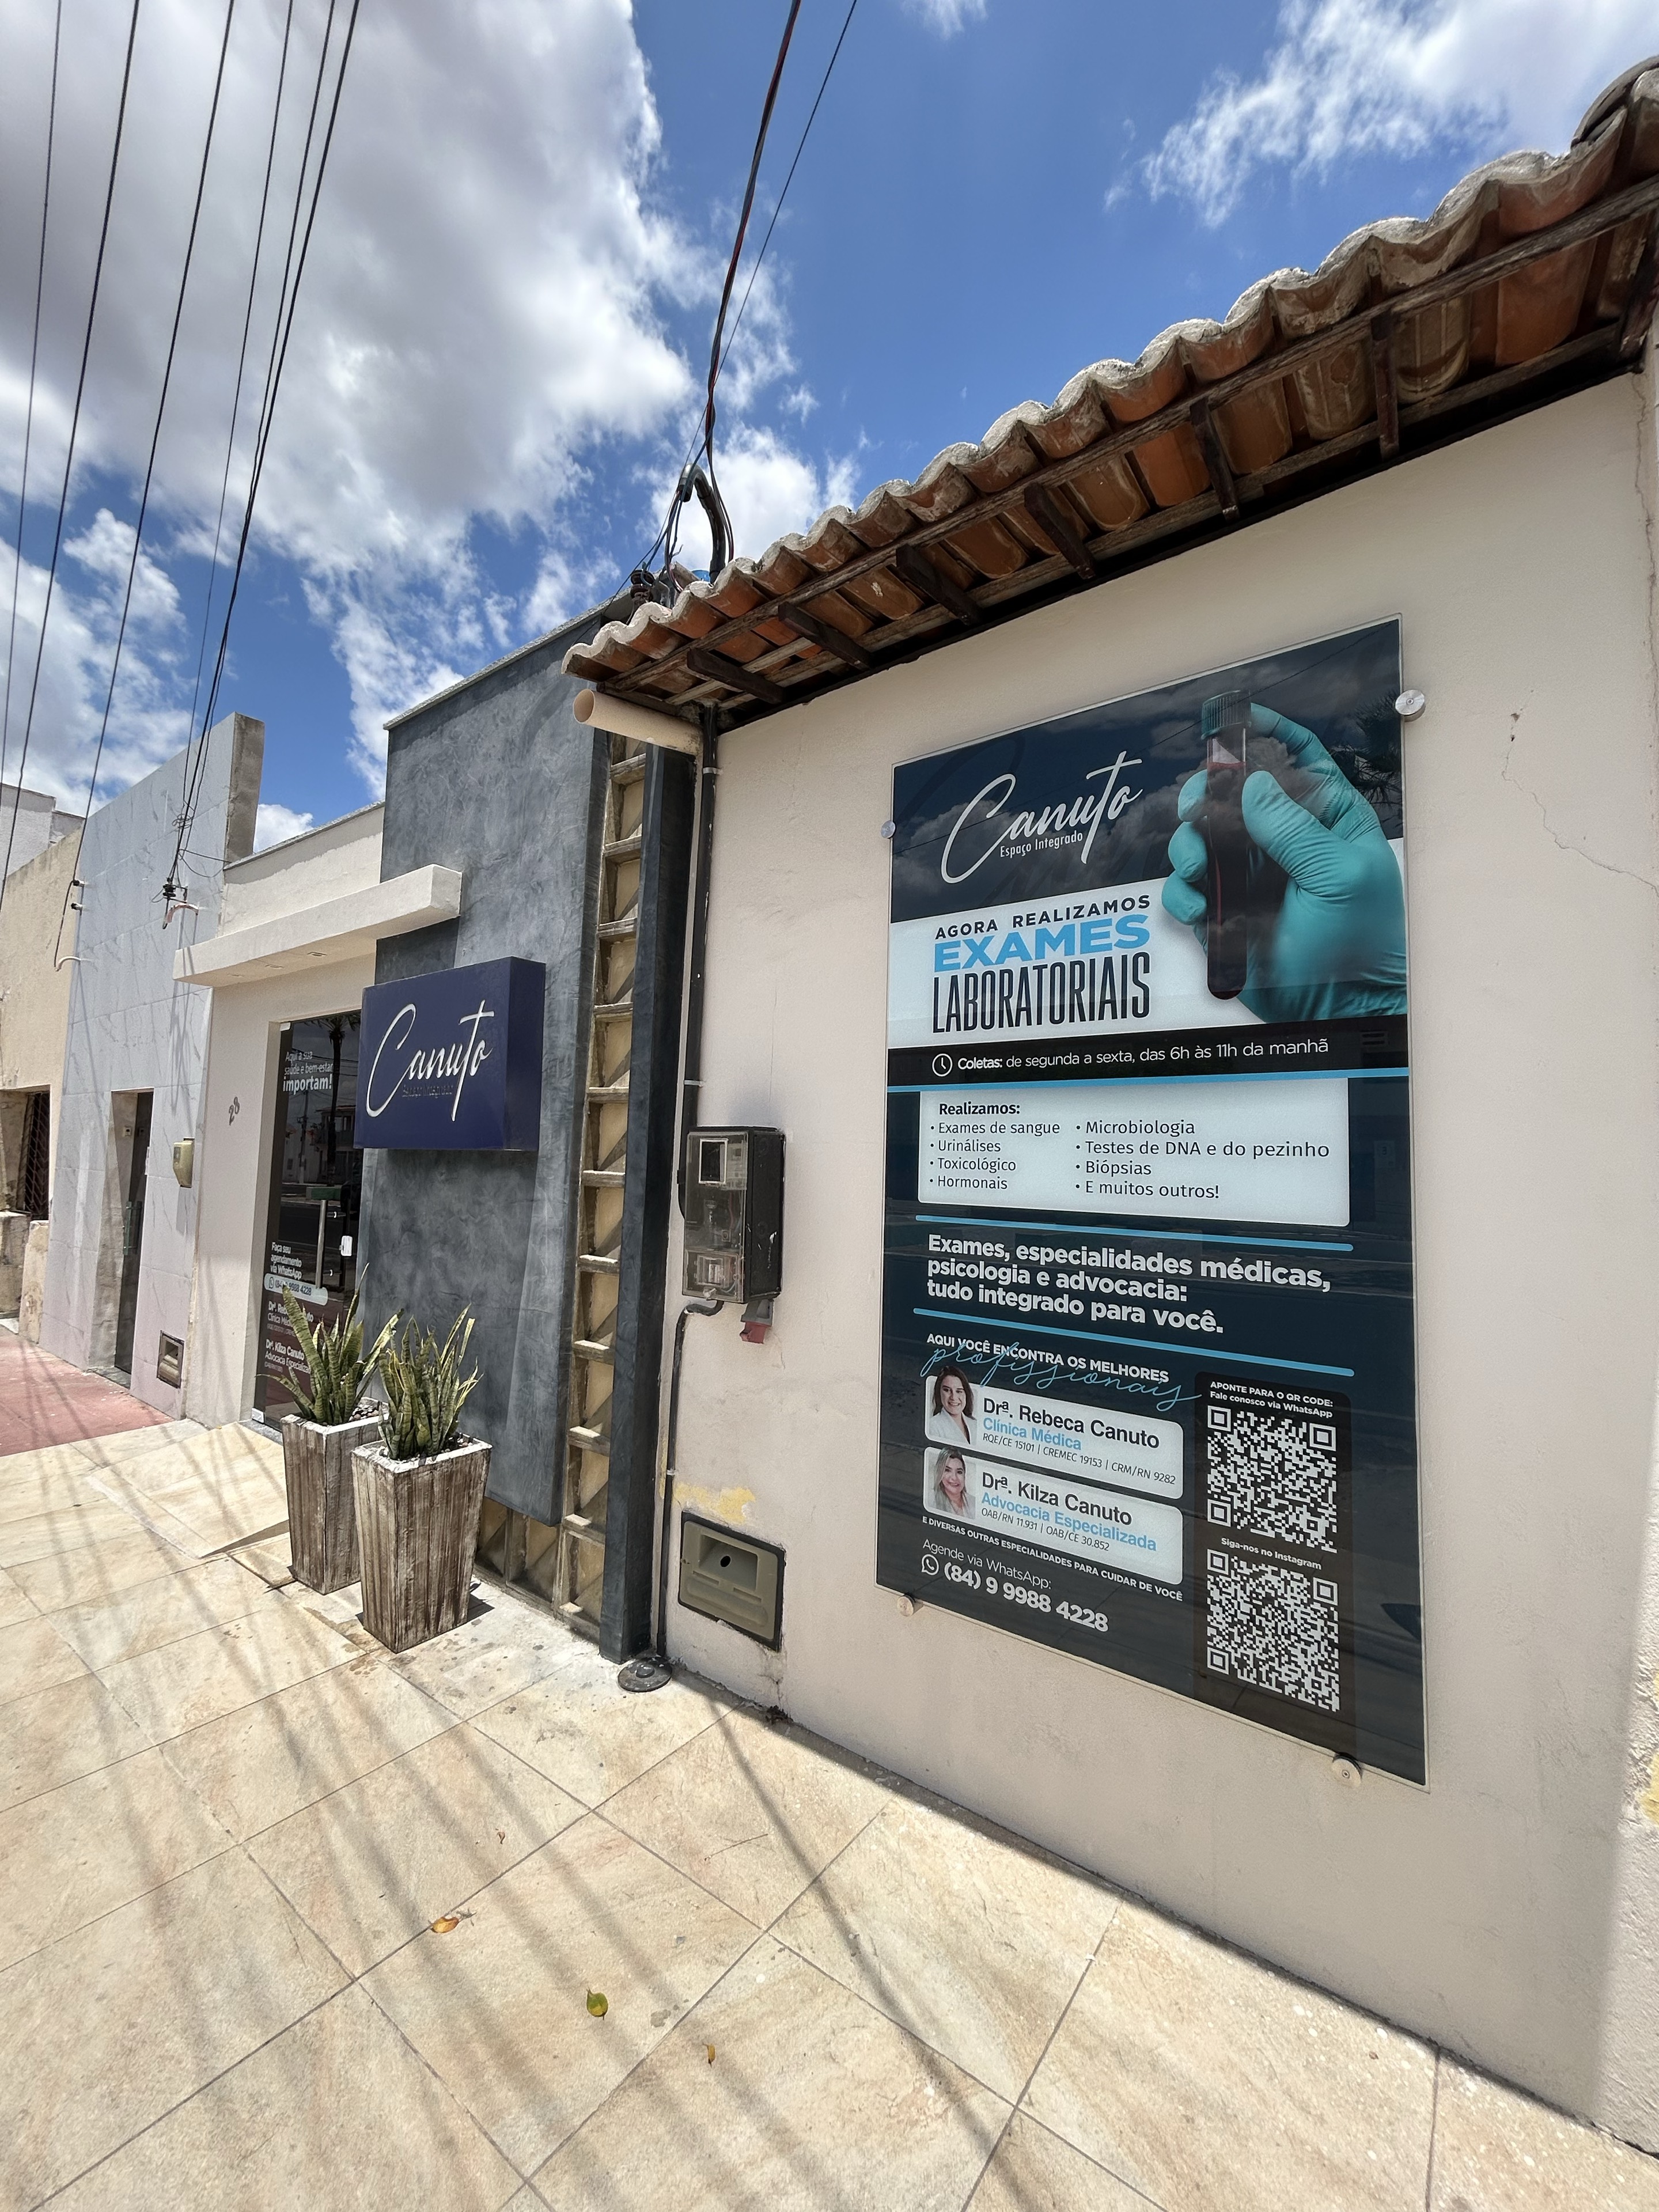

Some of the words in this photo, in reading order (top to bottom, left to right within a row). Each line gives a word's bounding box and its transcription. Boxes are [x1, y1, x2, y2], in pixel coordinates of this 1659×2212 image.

[941, 751, 1143, 884] Canuto
[1000, 842, 1031, 858] Espaço
[1035, 830, 1083, 850] Integrado
[935, 919, 998, 940] AGORA
[1013, 895, 1150, 928] REALIZAMOS
[934, 914, 1150, 972] EXAMES
[933, 952, 1150, 1033] LABORATORIAIS
[305, 1060, 333, 1074] bem-estar
[366, 999, 494, 1122] Canuto
[957, 1056, 1002, 1070] Coletas:
[1006, 1055, 1021, 1067] de
[1025, 1052, 1080, 1068] segunda
[1084, 1054, 1092, 1063] a
[1096, 1050, 1135, 1063] sexta,
[1139, 1048, 1165, 1062] das
[1170, 1046, 1190, 1060] 6h
[1195, 1045, 1211, 1059] às
[1216, 1043, 1237, 1058] 11h
[1243, 1042, 1263, 1056] da
[1269, 1038, 1328, 1055] manhã
[283, 1074, 332, 1095] importam!
[229, 1096, 240, 1126] 28
[939, 1101, 1020, 1115] Realizamos:
[938, 1122, 986, 1134] Exames
[990, 1121, 1006, 1134] de
[1010, 1122, 1060, 1137] sangue
[938, 1139, 1001, 1152] Urinálises
[1085, 1119, 1195, 1137] Microbiologia
[938, 1157, 1016, 1173] Toxicológico
[1085, 1141, 1134, 1154] Testes
[1139, 1140, 1160, 1154] de
[1165, 1142, 1201, 1156] DNA
[1207, 1144, 1217, 1156] e
[1223, 1141, 1246, 1157] do
[1252, 1141, 1330, 1160] pezinho
[1085, 1159, 1152, 1177] Biópsias
[937, 1175, 1007, 1190] Hormonais
[1085, 1181, 1094, 1194] E
[1099, 1180, 1154, 1196] muitos
[1159, 1184, 1220, 1199] outros!
[927, 1257, 1031, 1286] psicologia
[1036, 1271, 1050, 1286] e
[1056, 1270, 1187, 1302] advocacia:
[929, 1234, 1010, 1262] Exames,
[1016, 1245, 1193, 1275] especialidades
[1200, 1257, 1331, 1293] médicas,
[927, 1279, 974, 1301] tudo
[979, 1284, 1085, 1316] integrado
[1091, 1301, 1146, 1324] para
[1153, 1309, 1224, 1334] você.
[920, 1341, 1202, 1411] profissionais
[926, 1333, 955, 1347] AQUI
[957, 1338, 991, 1353] VOCÊ
[993, 1343, 1065, 1366] ENCONTRA
[1067, 1355, 1086, 1369] OS
[1090, 1359, 1170, 1383] MELHORES
[1210, 1381, 1247, 1393] APONTE
[1249, 1387, 1275, 1398] PARA
[1286, 1393, 1301, 1402] QR
[1302, 1396, 1333, 1407] CODE:
[1210, 1391, 1227, 1400] Fale
[1229, 1395, 1266, 1407] conosco
[1267, 1400, 1281, 1410] via
[1283, 1402, 1333, 1419] WhatsApp
[983, 1417, 1027, 1438] Clínica
[1032, 1427, 1082, 1450] Médica
[1019, 1405, 1085, 1433] Rebeca
[1090, 1419, 1160, 1449] Canuto
[983, 1433, 1012, 1448] RQE/CE
[1015, 1441, 1035, 1452] 15101
[1043, 1446, 1077, 1462] CREMEC
[1080, 1455, 1102, 1468] 19153
[1112, 1462, 1151, 1479] CRM/RN
[1154, 1472, 1176, 1485] 9282
[982, 1493, 1050, 1522] Advocacia
[1055, 1511, 1157, 1551] Especializada
[1018, 1481, 1059, 1506] Kilza
[1065, 1493, 1132, 1526] Canuto
[982, 1508, 1013, 1524] OAB/RN
[1017, 1518, 1037, 1531] 11.931
[1046, 1527, 1079, 1543] OAB/CE
[1081, 1536, 1110, 1551] 30.852
[922, 1516, 927, 1524] E
[929, 1518, 965, 1535] DIVERSAS
[967, 1530, 999, 1546] OUTRAS
[1001, 1540, 1072, 1568] ESPECIALIDADES
[1074, 1562, 1099, 1577] PARA
[1101, 1569, 1137, 1588] CUIDAR
[1139, 1580, 1153, 1593] DE
[1154, 1585, 1183, 1602] VOCÊ
[923, 1539, 964, 1561] Agende
[967, 1554, 983, 1567] via
[986, 1558, 1052, 1590] WhatsApp:
[1221, 1537, 1259, 1554] Siga-nos
[1275, 1551, 1321, 1570] Instagram
[944, 1562, 981, 1590] (84)
[986, 1577, 998, 1594] 9
[1003, 1582, 1052, 1613] 9988
[1056, 1601, 1109, 1633] 4228
